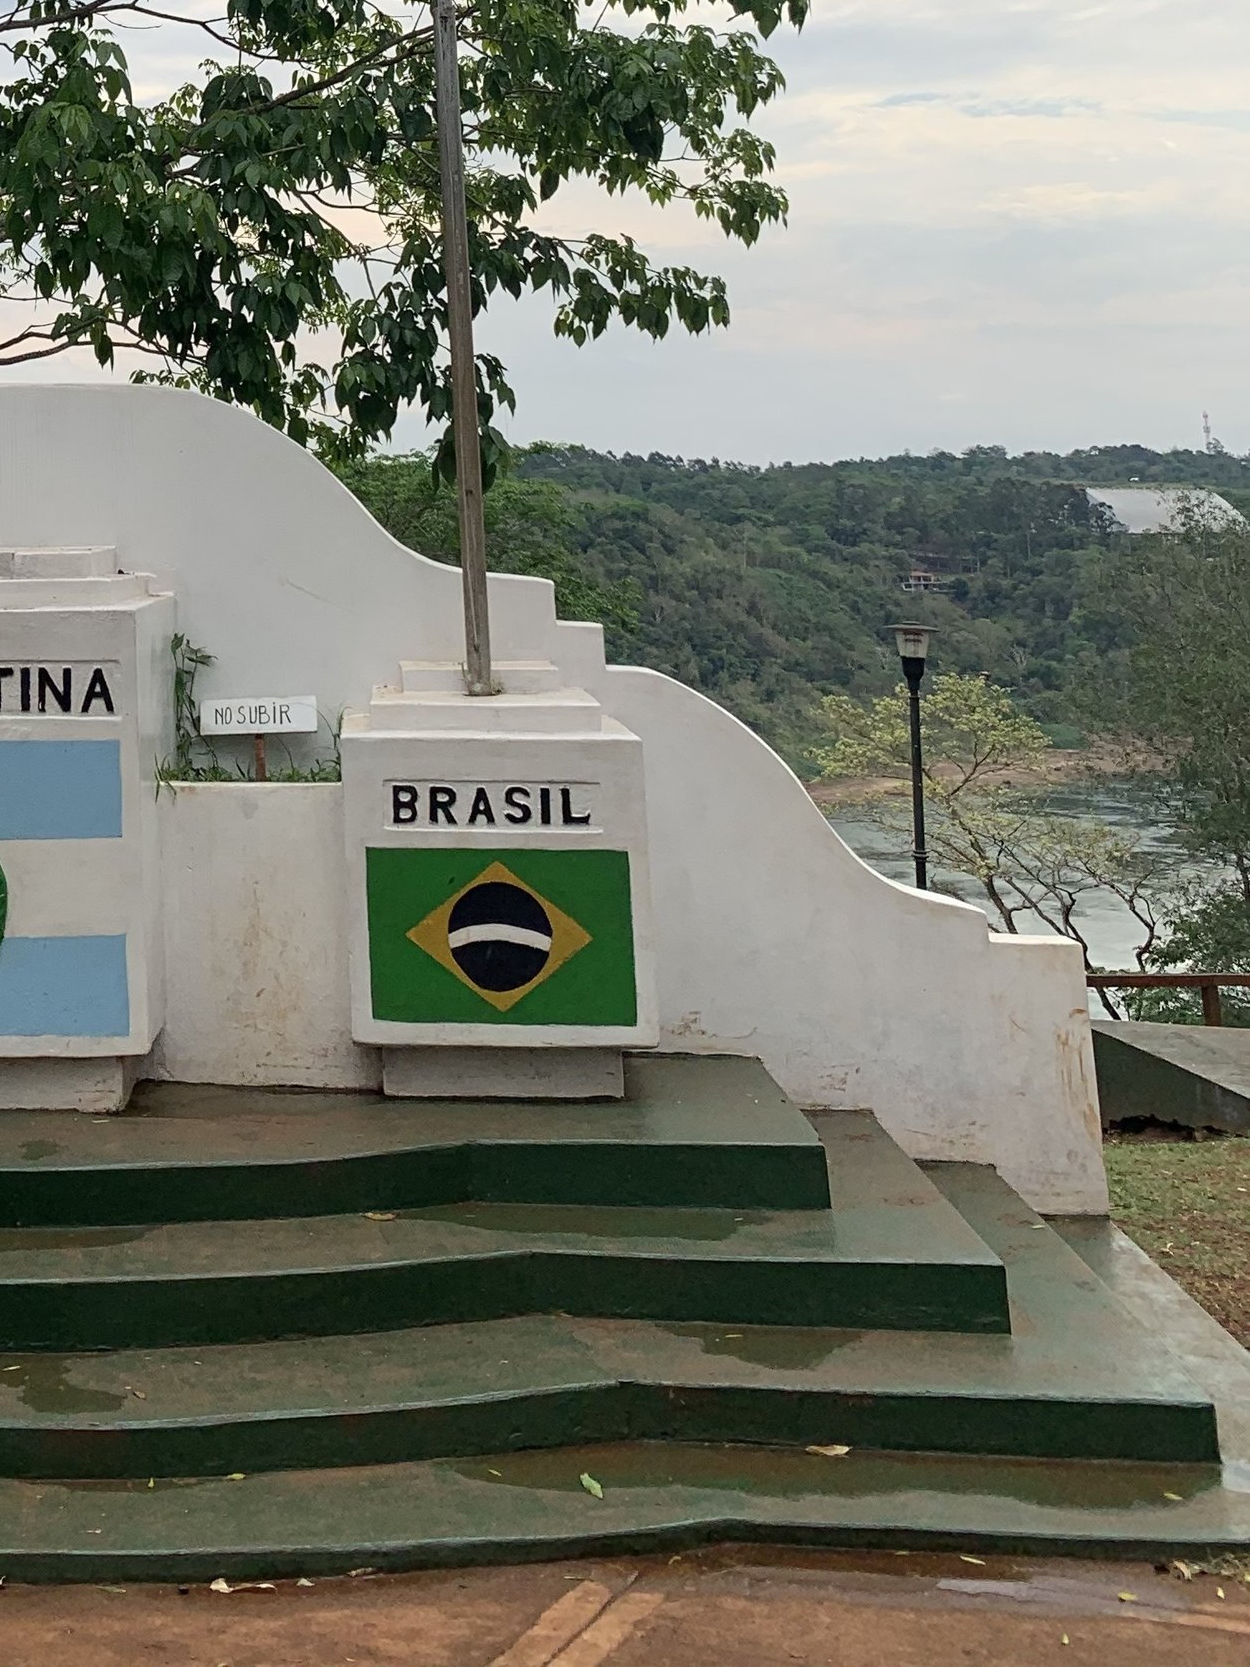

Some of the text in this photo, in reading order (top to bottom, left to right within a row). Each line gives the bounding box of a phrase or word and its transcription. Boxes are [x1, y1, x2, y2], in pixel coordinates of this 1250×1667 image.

[214, 701, 292, 726] NO SUBIR
[391, 783, 592, 827] BRASIL
